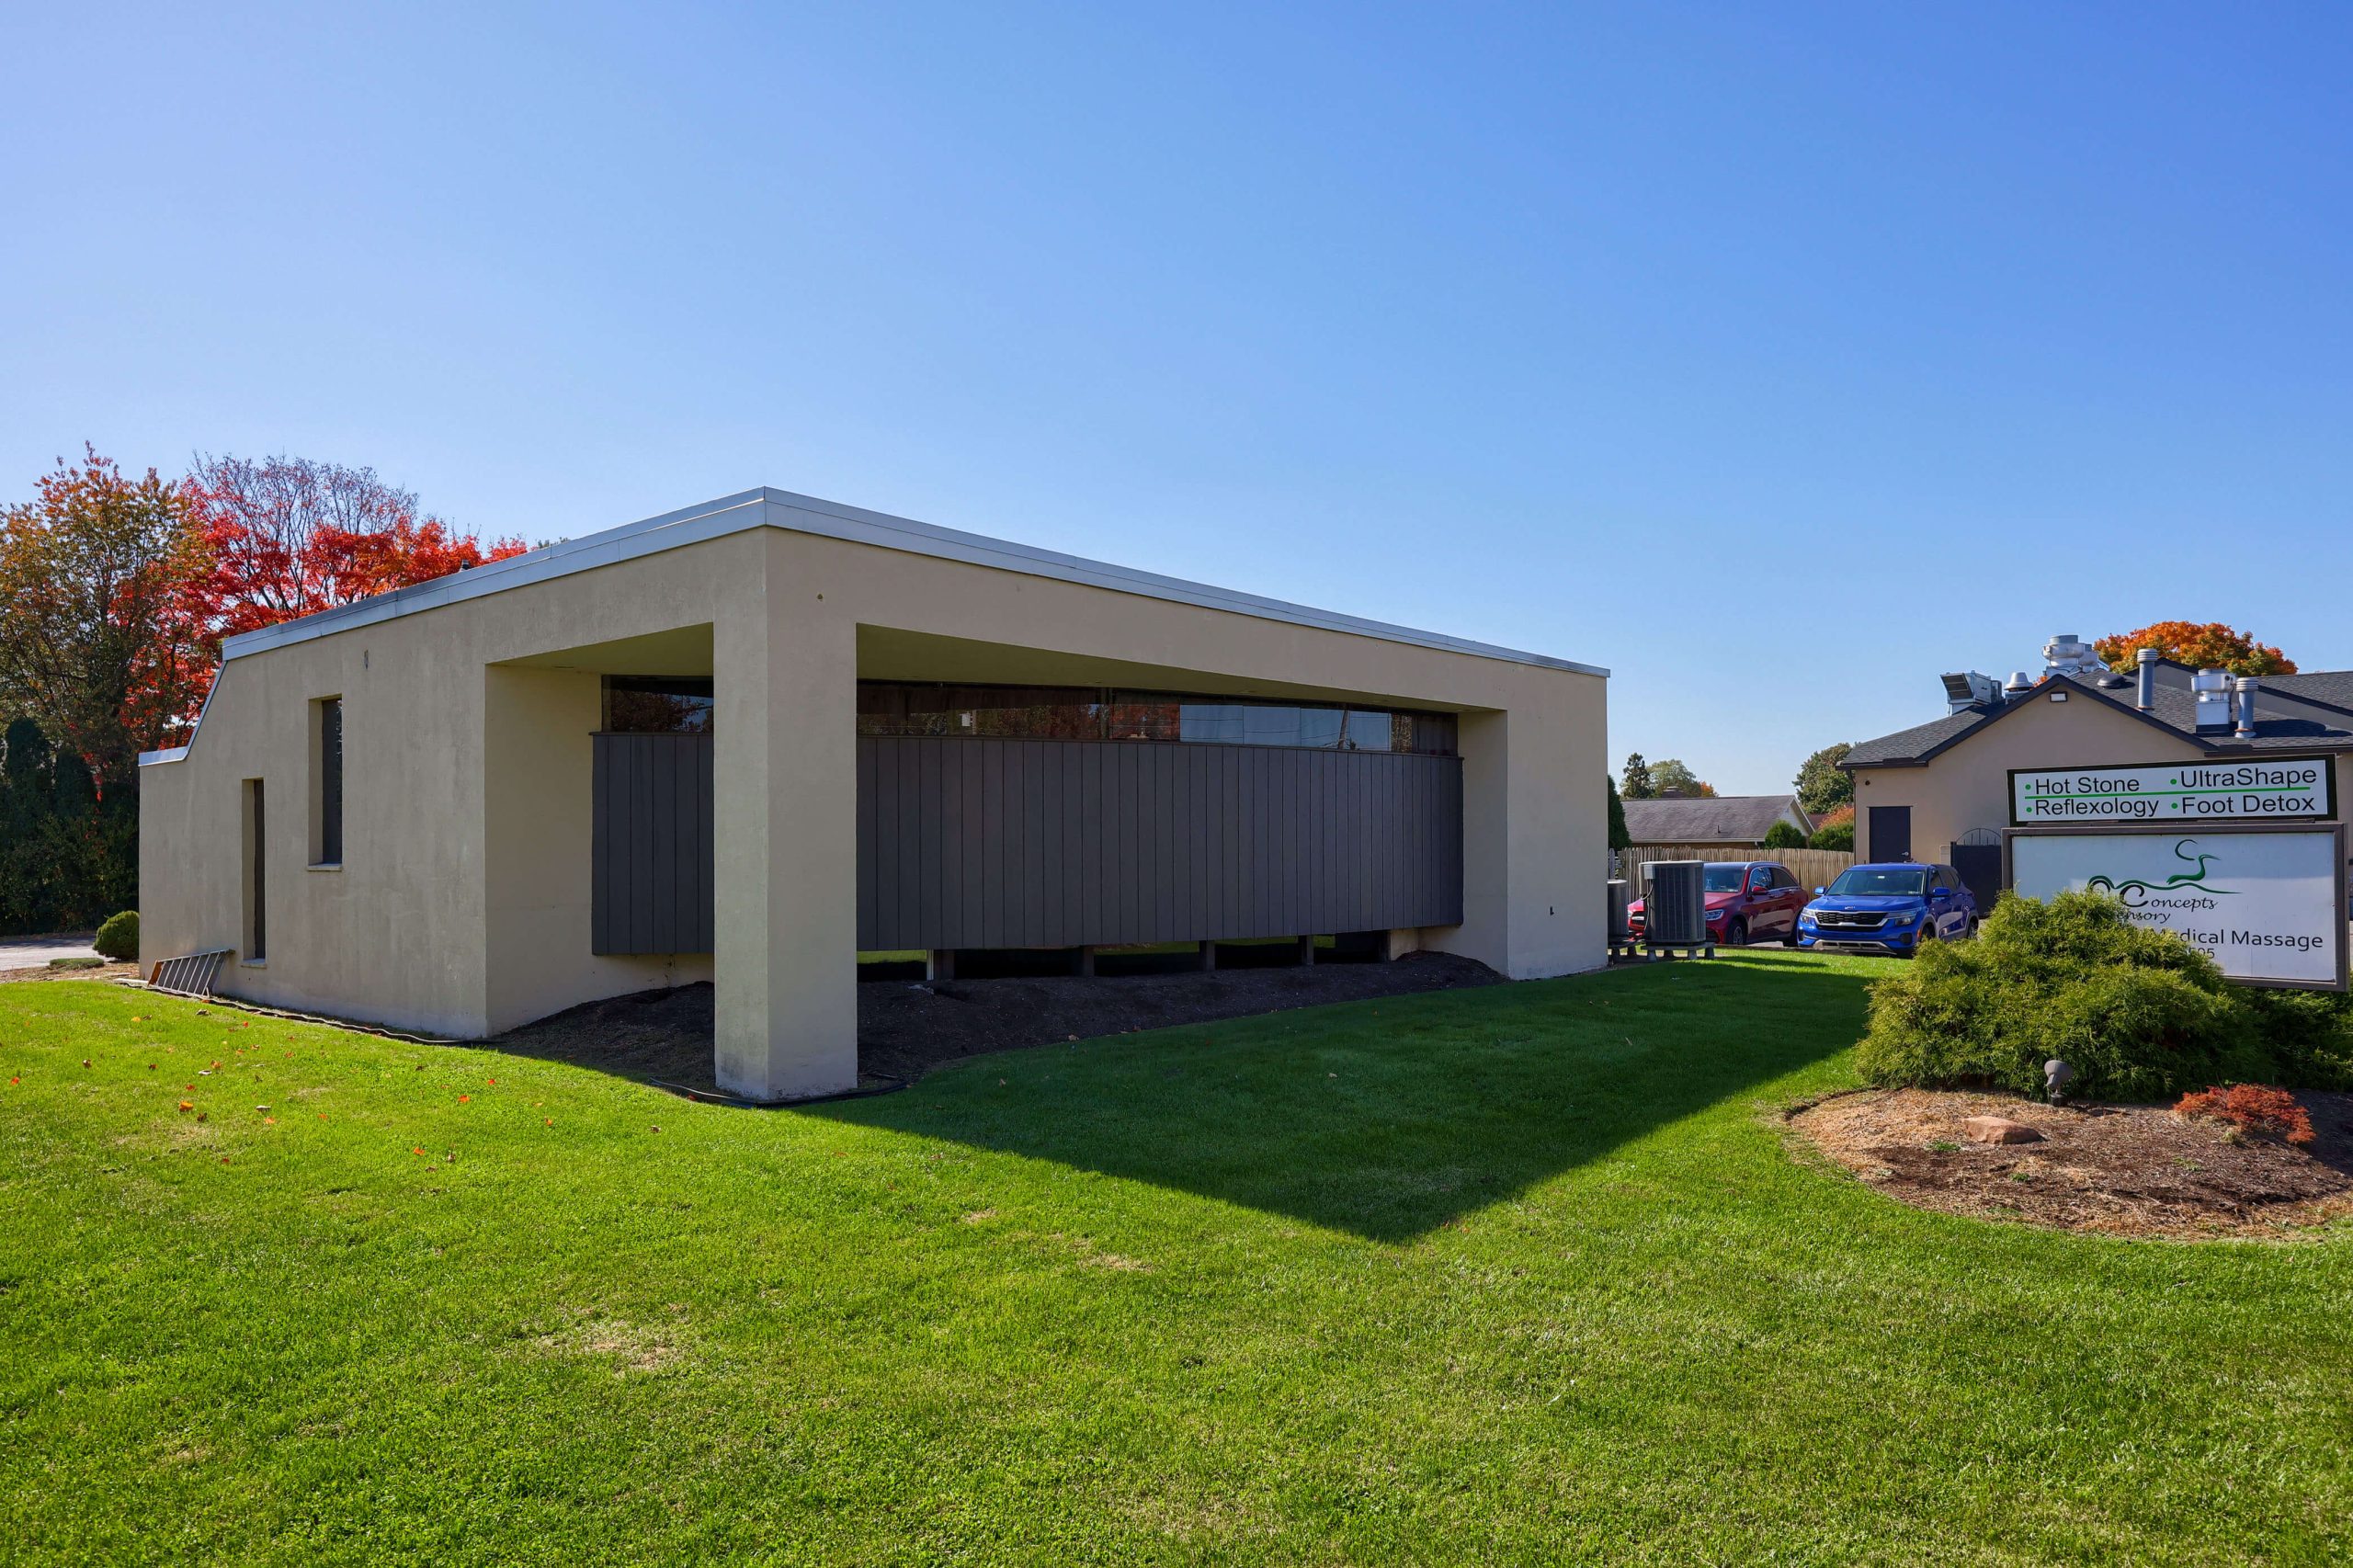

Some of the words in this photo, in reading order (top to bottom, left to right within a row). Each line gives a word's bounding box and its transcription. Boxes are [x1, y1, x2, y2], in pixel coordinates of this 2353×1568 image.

[2035, 778, 2070, 794] Hot
[2077, 777, 2140, 793] Stone
[2180, 767, 2316, 789] UltraShape
[2035, 798, 2159, 817] Reflexology
[2182, 796, 2234, 814] Foot
[2243, 794, 2315, 812] Detox
[2120, 884, 2218, 912] Concepts
[2231, 930, 2324, 952] Massage
